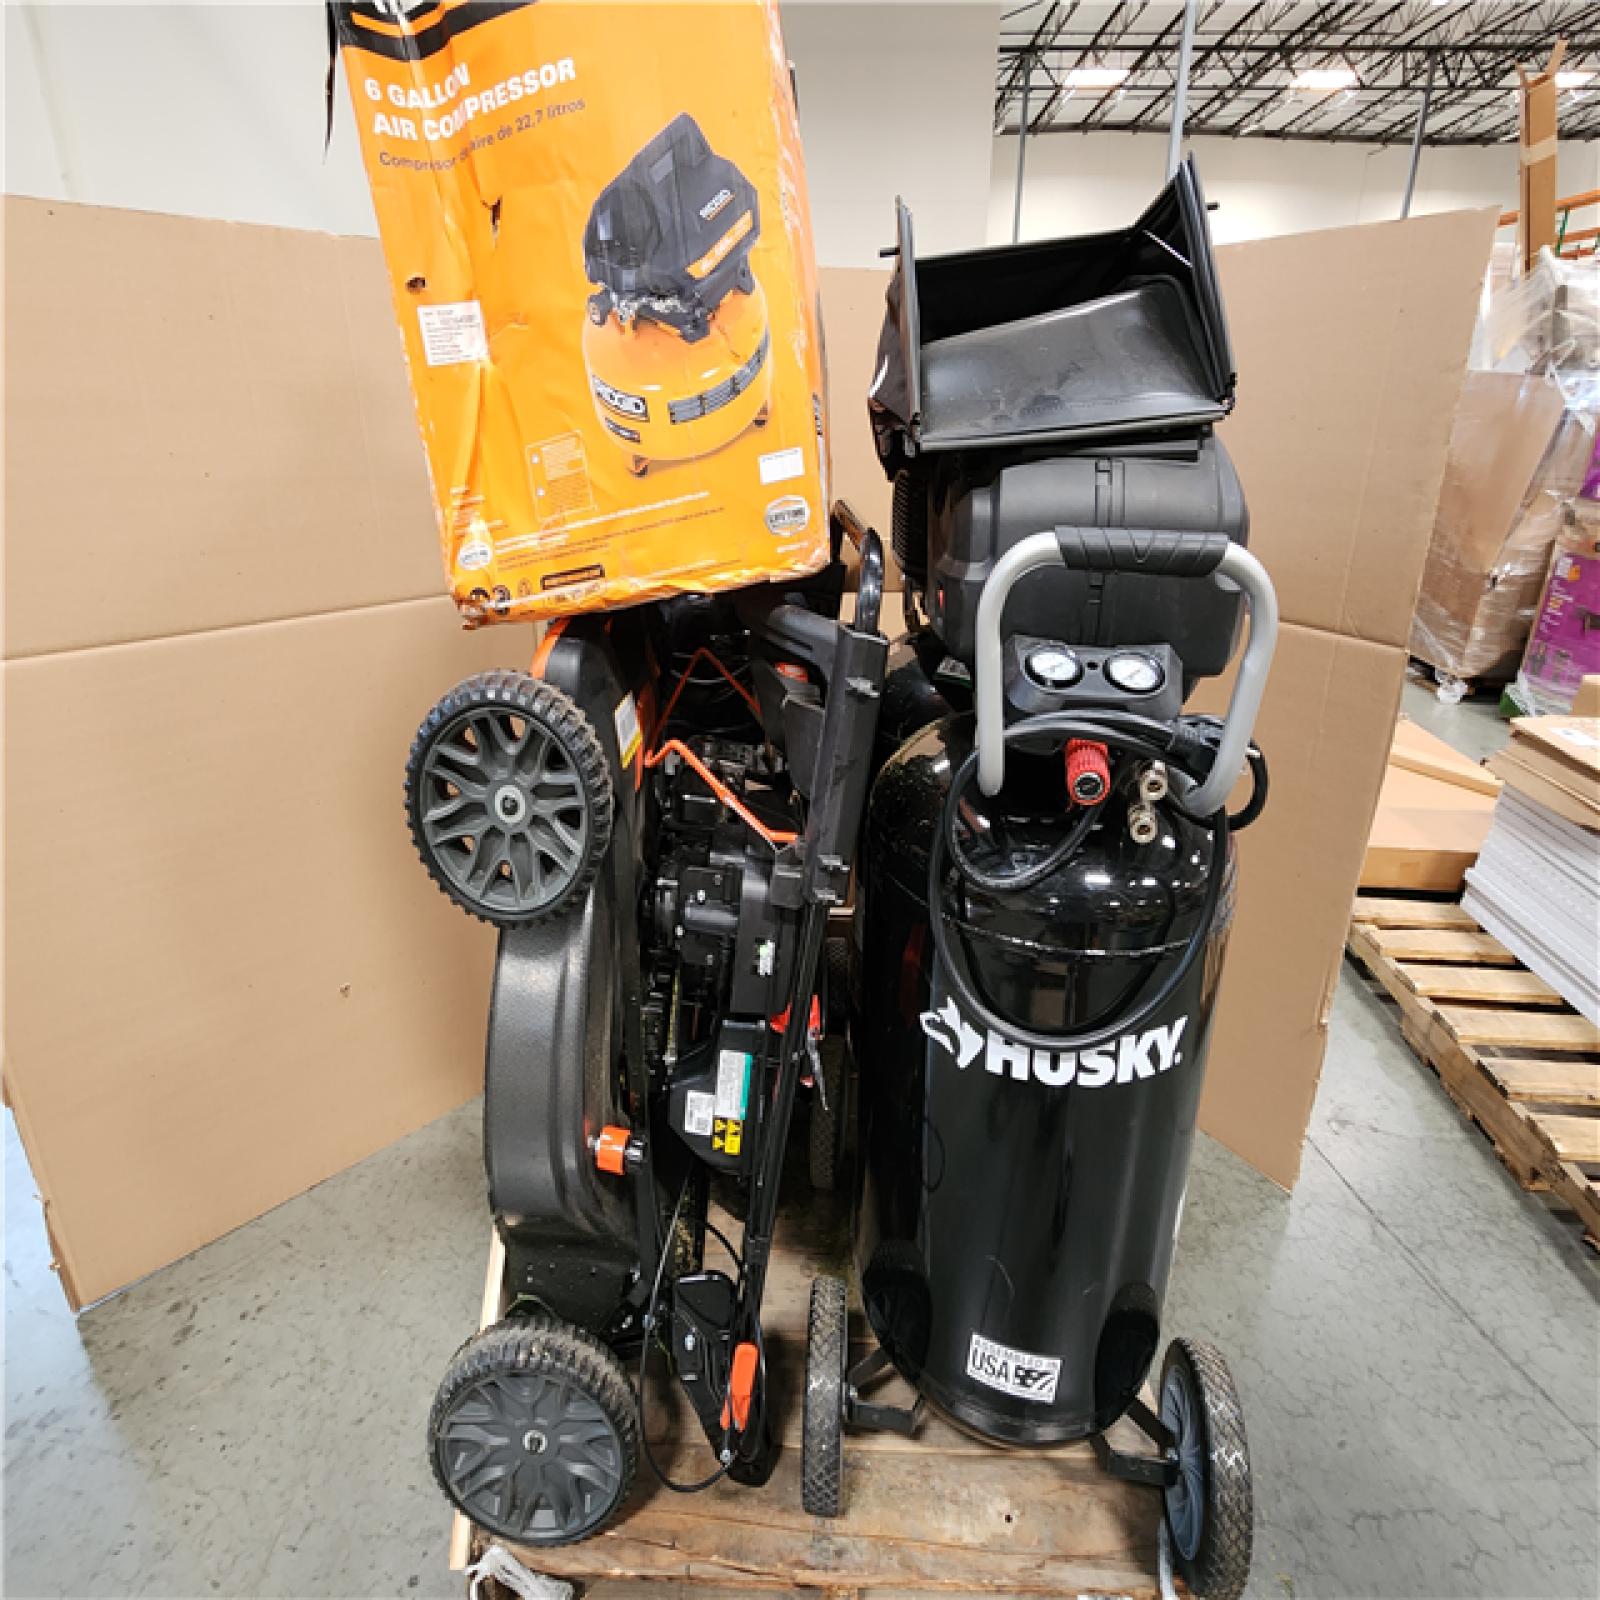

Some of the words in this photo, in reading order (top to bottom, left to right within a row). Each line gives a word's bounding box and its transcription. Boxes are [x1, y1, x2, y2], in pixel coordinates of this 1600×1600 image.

[364, 78, 382, 101] 6
[387, 62, 470, 109] GALLON
[374, 112, 417, 141] AIR
[423, 57, 576, 141] COMPRESSOR
[497, 125, 513, 141] de
[547, 99, 586, 118] litros
[973, 1347, 1008, 1382] USA
